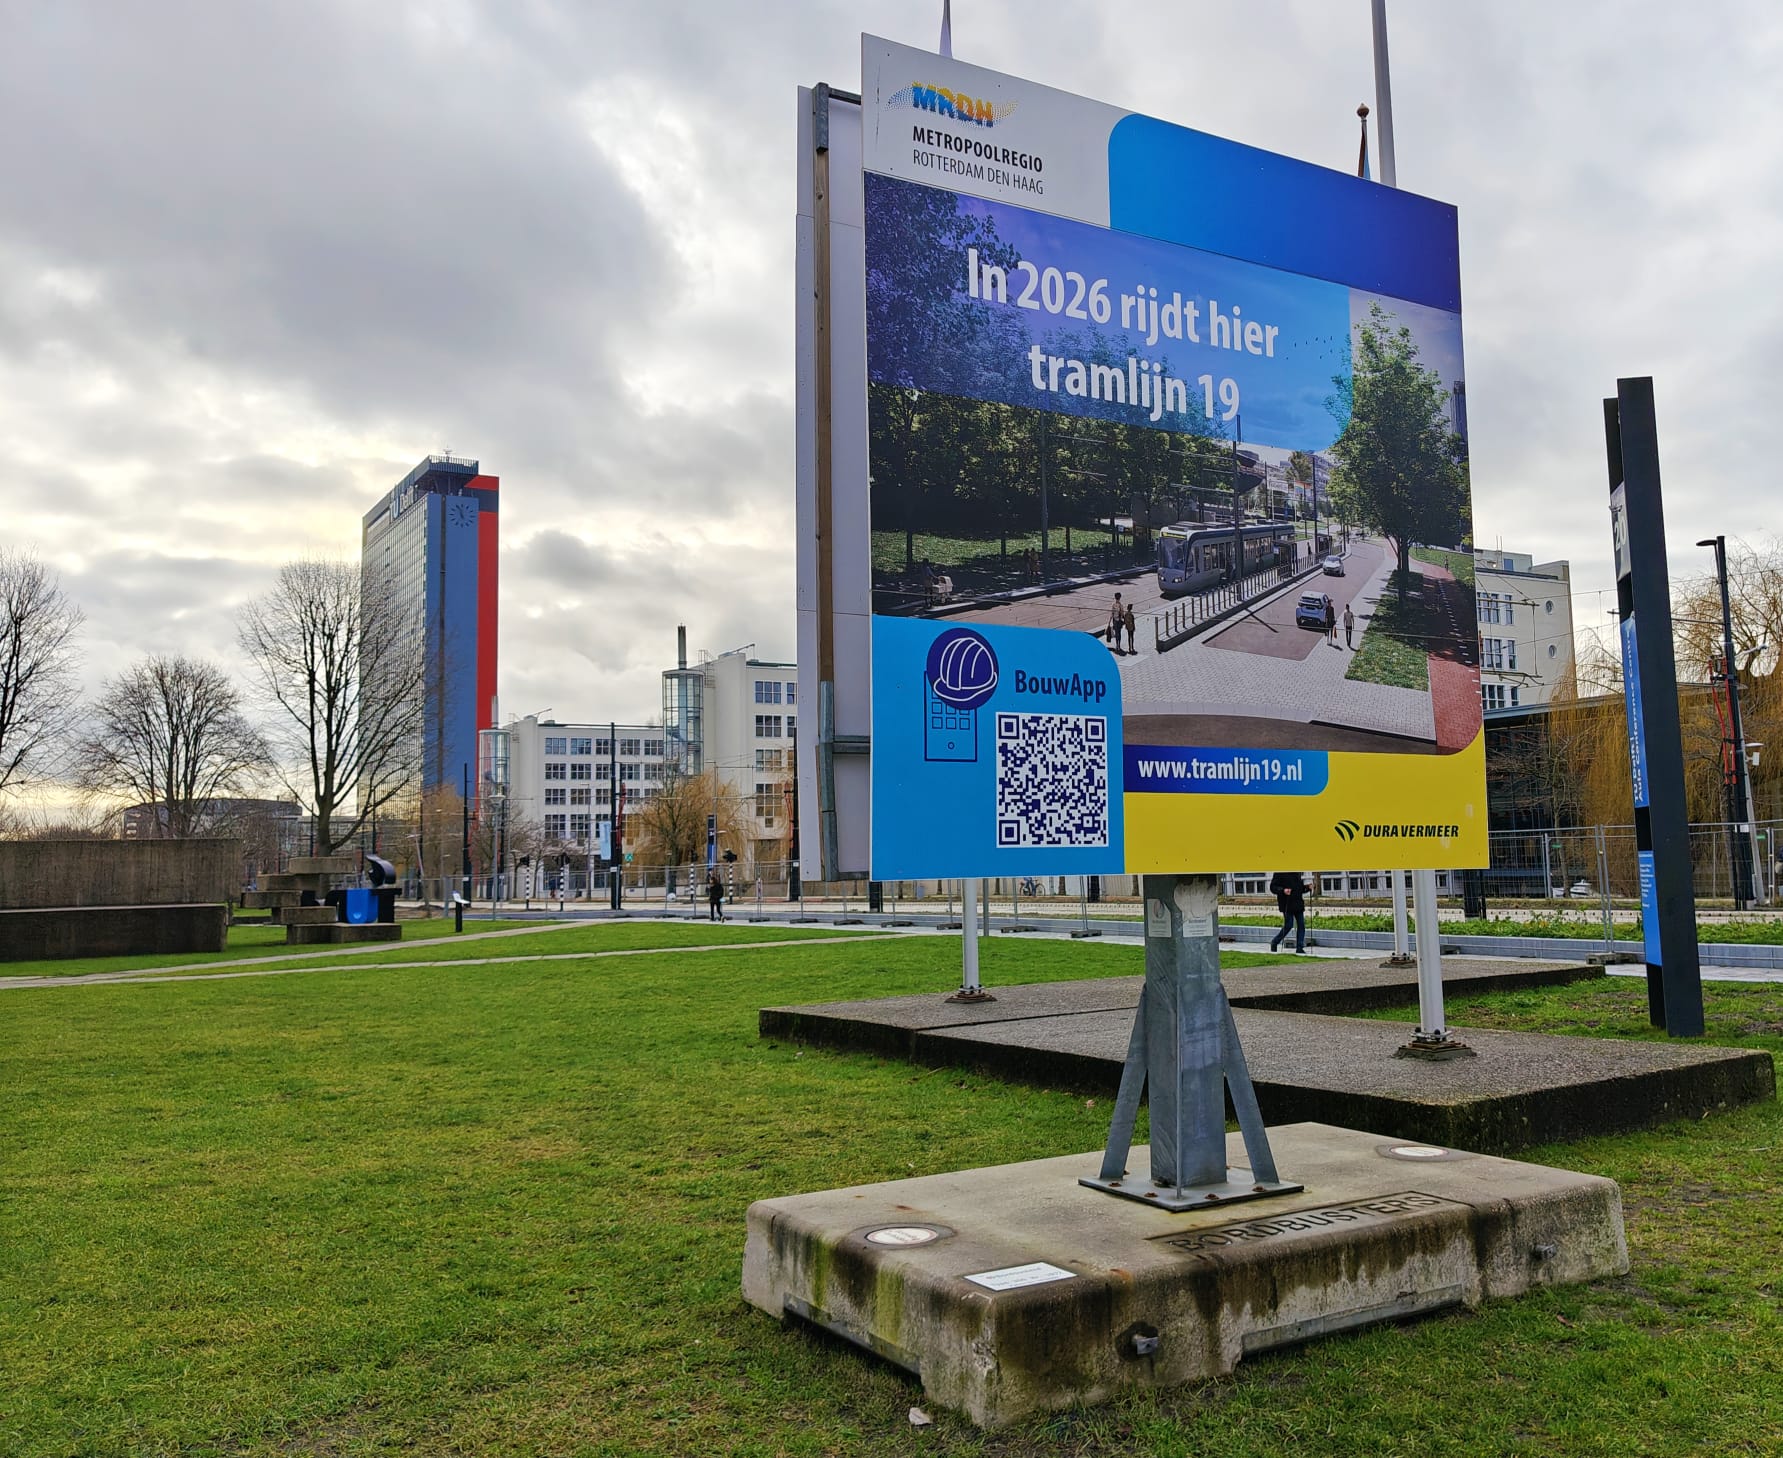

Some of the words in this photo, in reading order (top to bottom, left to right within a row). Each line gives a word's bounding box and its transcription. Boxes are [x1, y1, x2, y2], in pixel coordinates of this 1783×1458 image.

[911, 81, 994, 128] MRDH
[912, 125, 1043, 173] METROPOOLREGIO
[912, 149, 984, 180] ROTTERDAM
[986, 167, 1010, 187] DEN
[1012, 174, 1044, 195] HAAG
[967, 247, 1007, 305] In
[1016, 260, 1112, 325] 2026
[1120, 284, 1200, 347] rijdt
[1208, 299, 1279, 358] hier
[1027, 344, 1187, 422] tramlijn
[1197, 373, 1240, 421] 19
[1014, 669, 1107, 704] BouwApp
[1137, 757, 1303, 786] www.tramlijn19.nl
[1363, 824, 1398, 838] DURA
[1399, 824, 1459, 838] VERMEER
[1167, 1195, 1441, 1251] BORDBUSTERS
